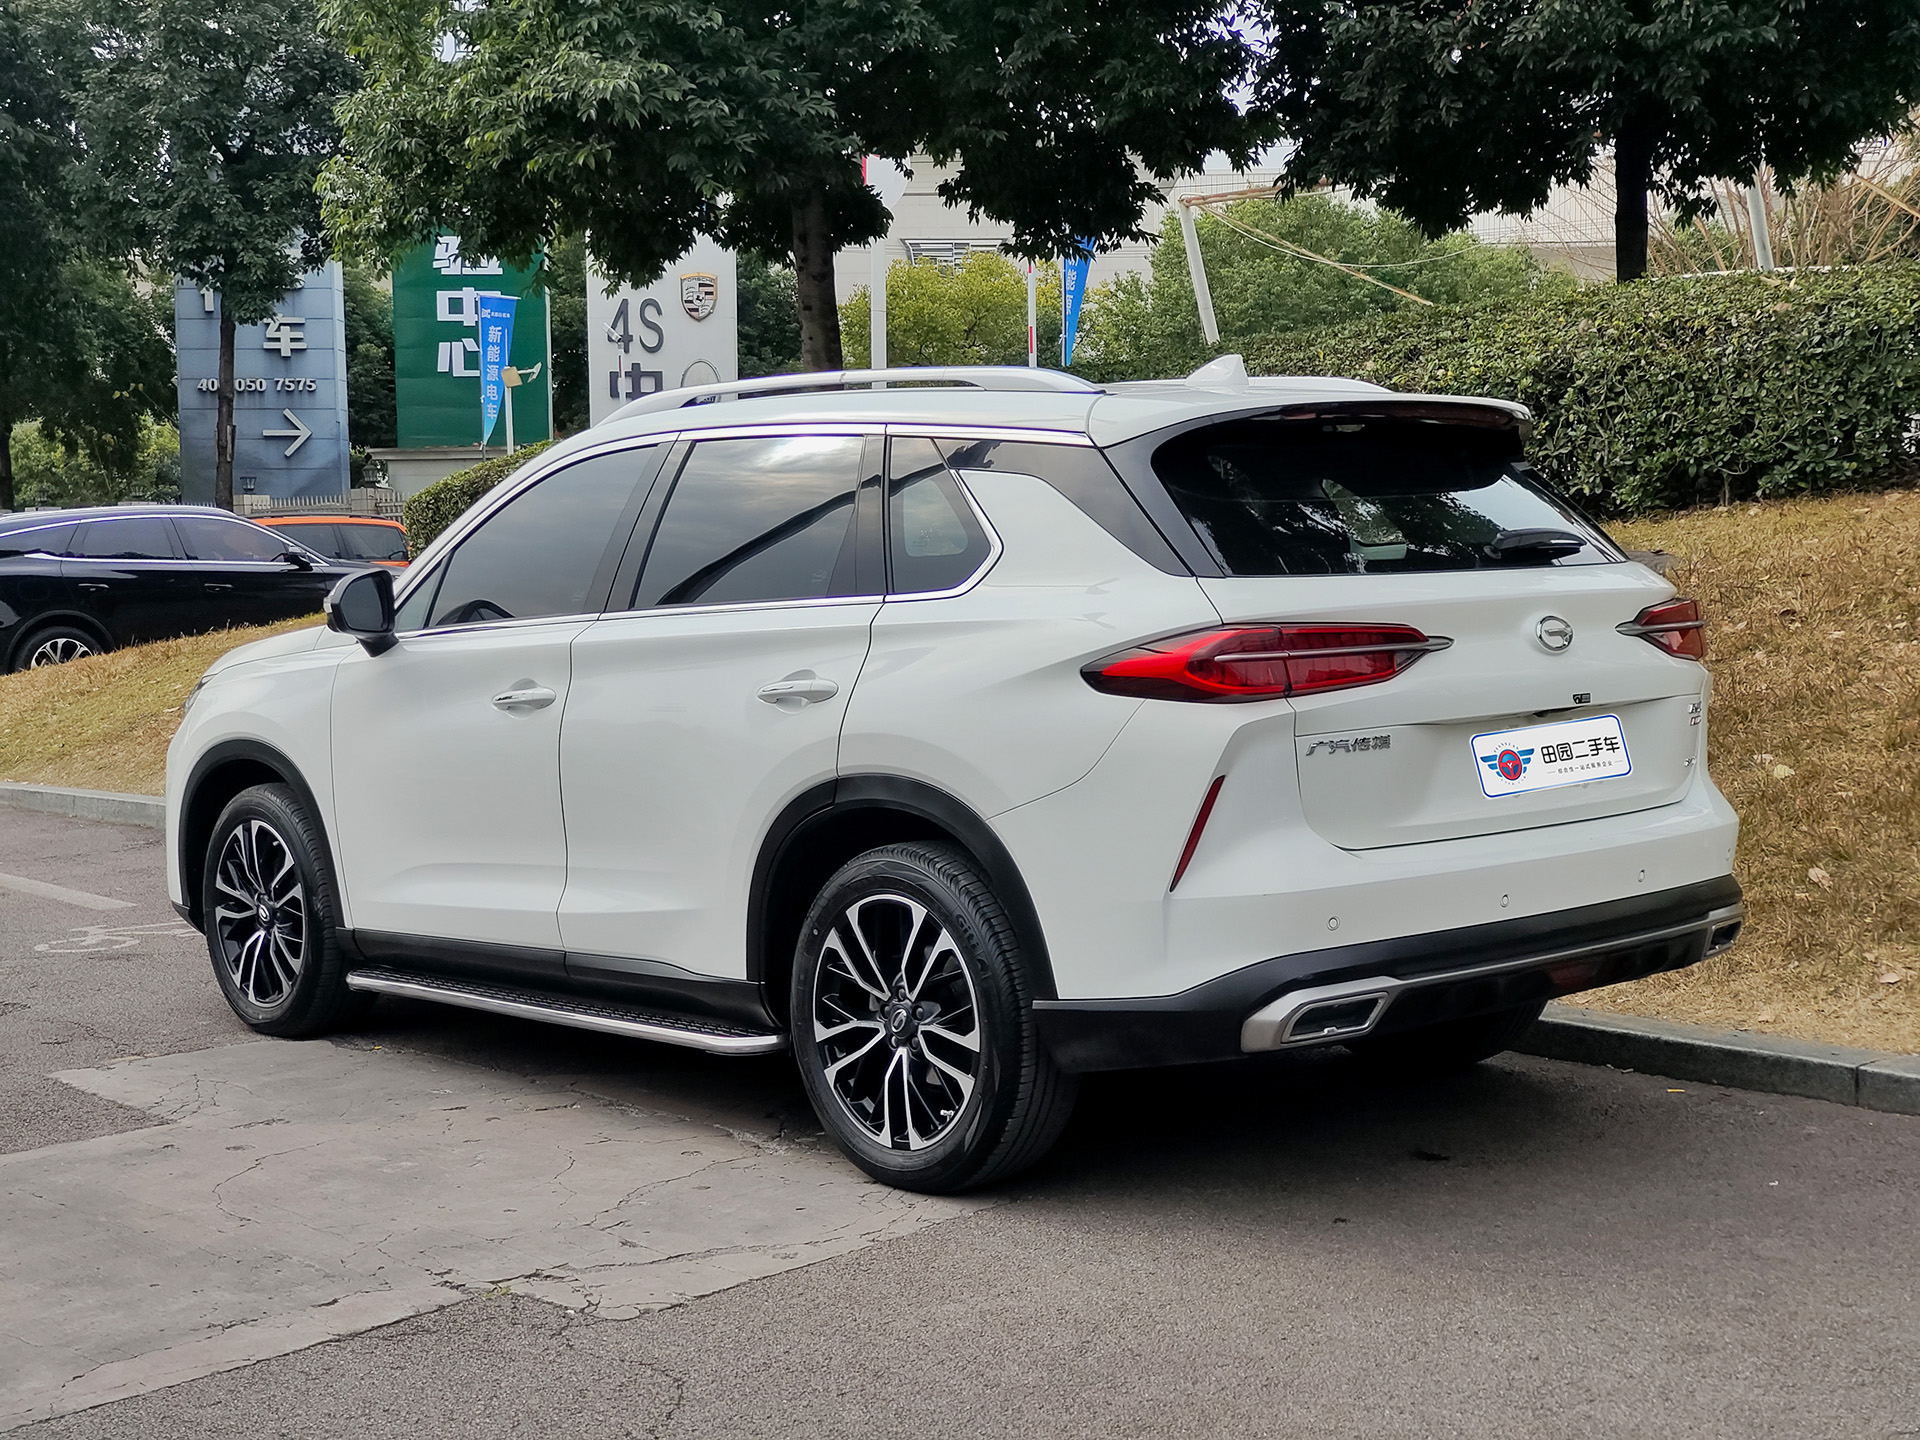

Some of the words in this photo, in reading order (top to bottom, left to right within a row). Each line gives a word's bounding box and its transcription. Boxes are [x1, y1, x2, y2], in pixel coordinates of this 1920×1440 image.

[607, 298, 665, 354] 4S
[197, 378, 221, 393] 40
[234, 378, 267, 392] 050
[274, 377, 317, 392] 7575
[486, 324, 503, 420] 新能源电车
[955, 914, 980, 950] Giti
